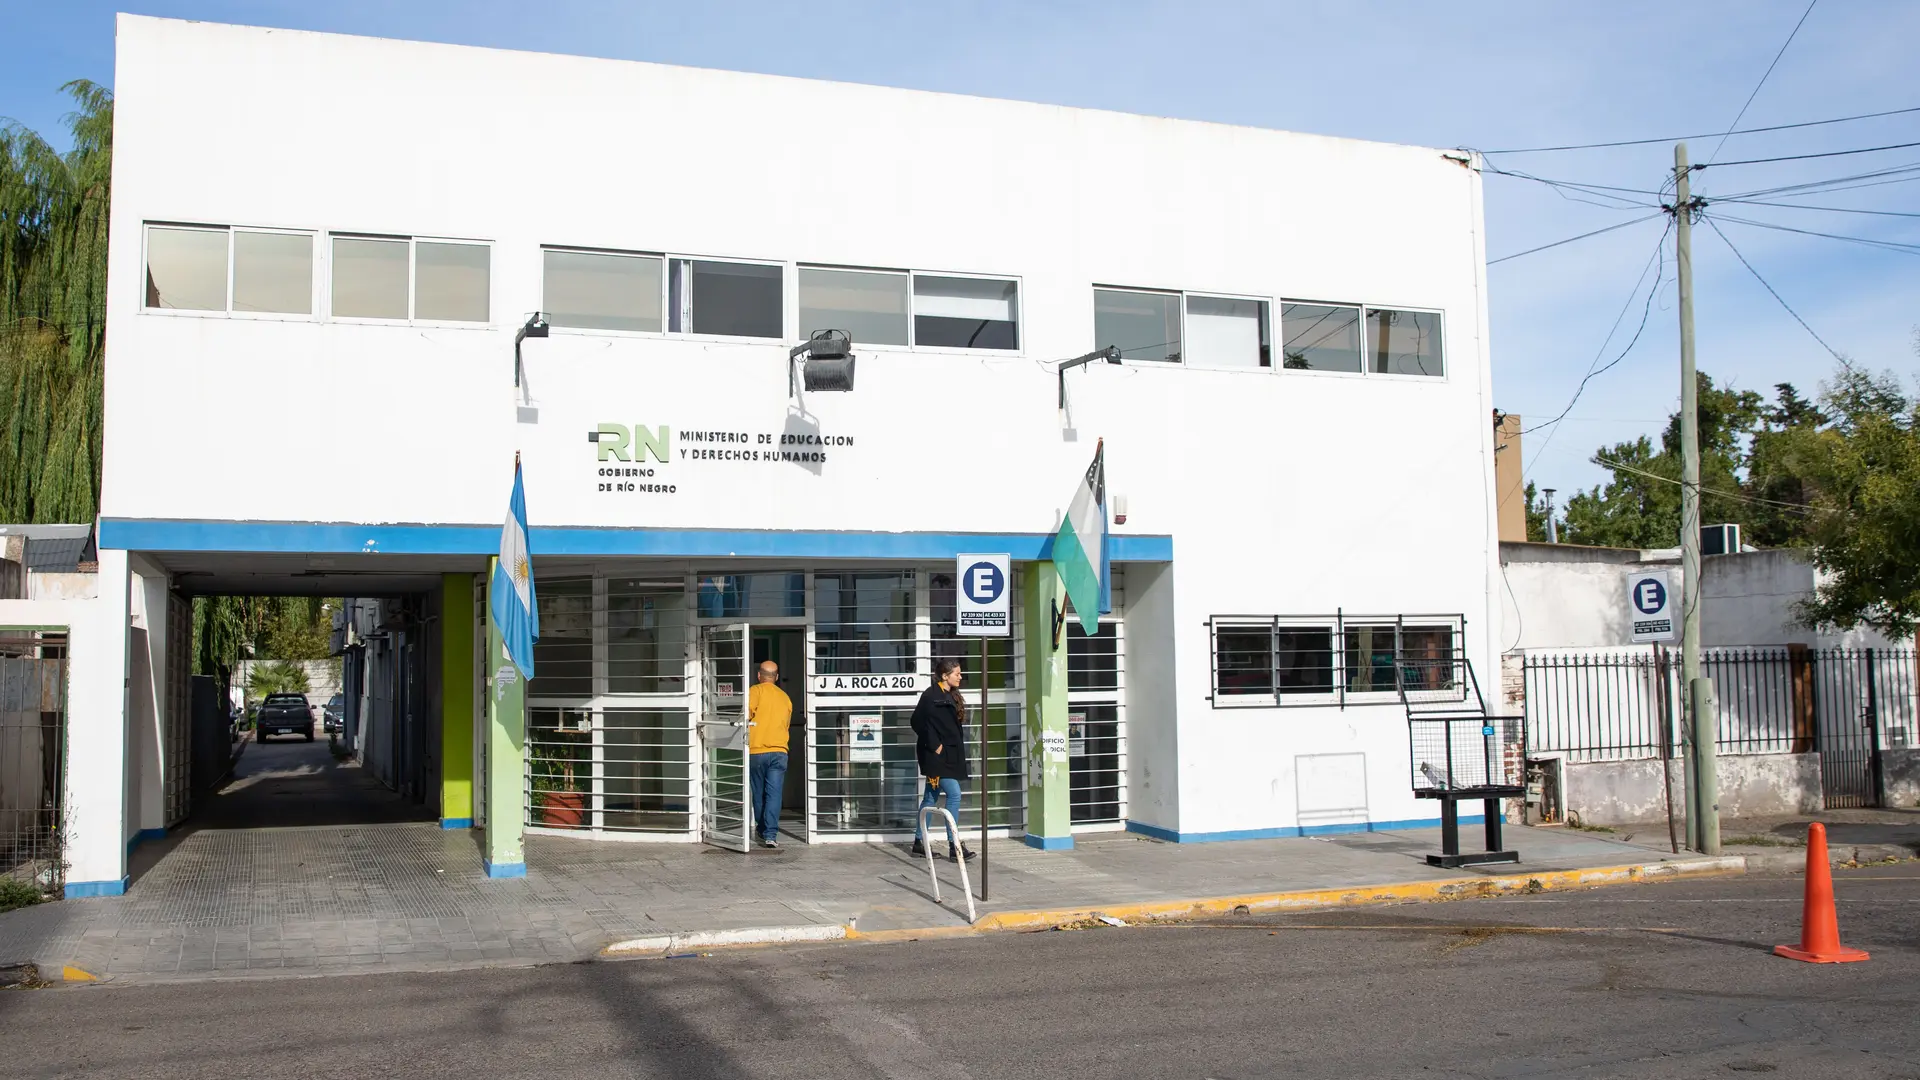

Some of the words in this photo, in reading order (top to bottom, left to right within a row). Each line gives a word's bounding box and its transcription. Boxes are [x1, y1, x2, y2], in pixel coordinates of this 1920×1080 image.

[598, 423, 669, 463] RN
[680, 431, 749, 443] MINISTERIO
[758, 433, 772, 444] DE
[781, 434, 854, 446] EDUCACION
[680, 449, 687, 459] Y
[692, 449, 758, 461] DERECHOS
[763, 451, 827, 463] HUMANOS
[598, 468, 655, 477] GOBIERNO
[598, 483, 612, 492] DE
[617, 481, 635, 492] RÍO
[640, 484, 677, 493] NEGRO
[973, 568, 994, 598] E
[1640, 583, 1659, 609] E
[820, 677, 827, 689] J
[835, 677, 847, 689] A.
[852, 677, 888, 688] ROCA
[892, 676, 914, 688] 260
